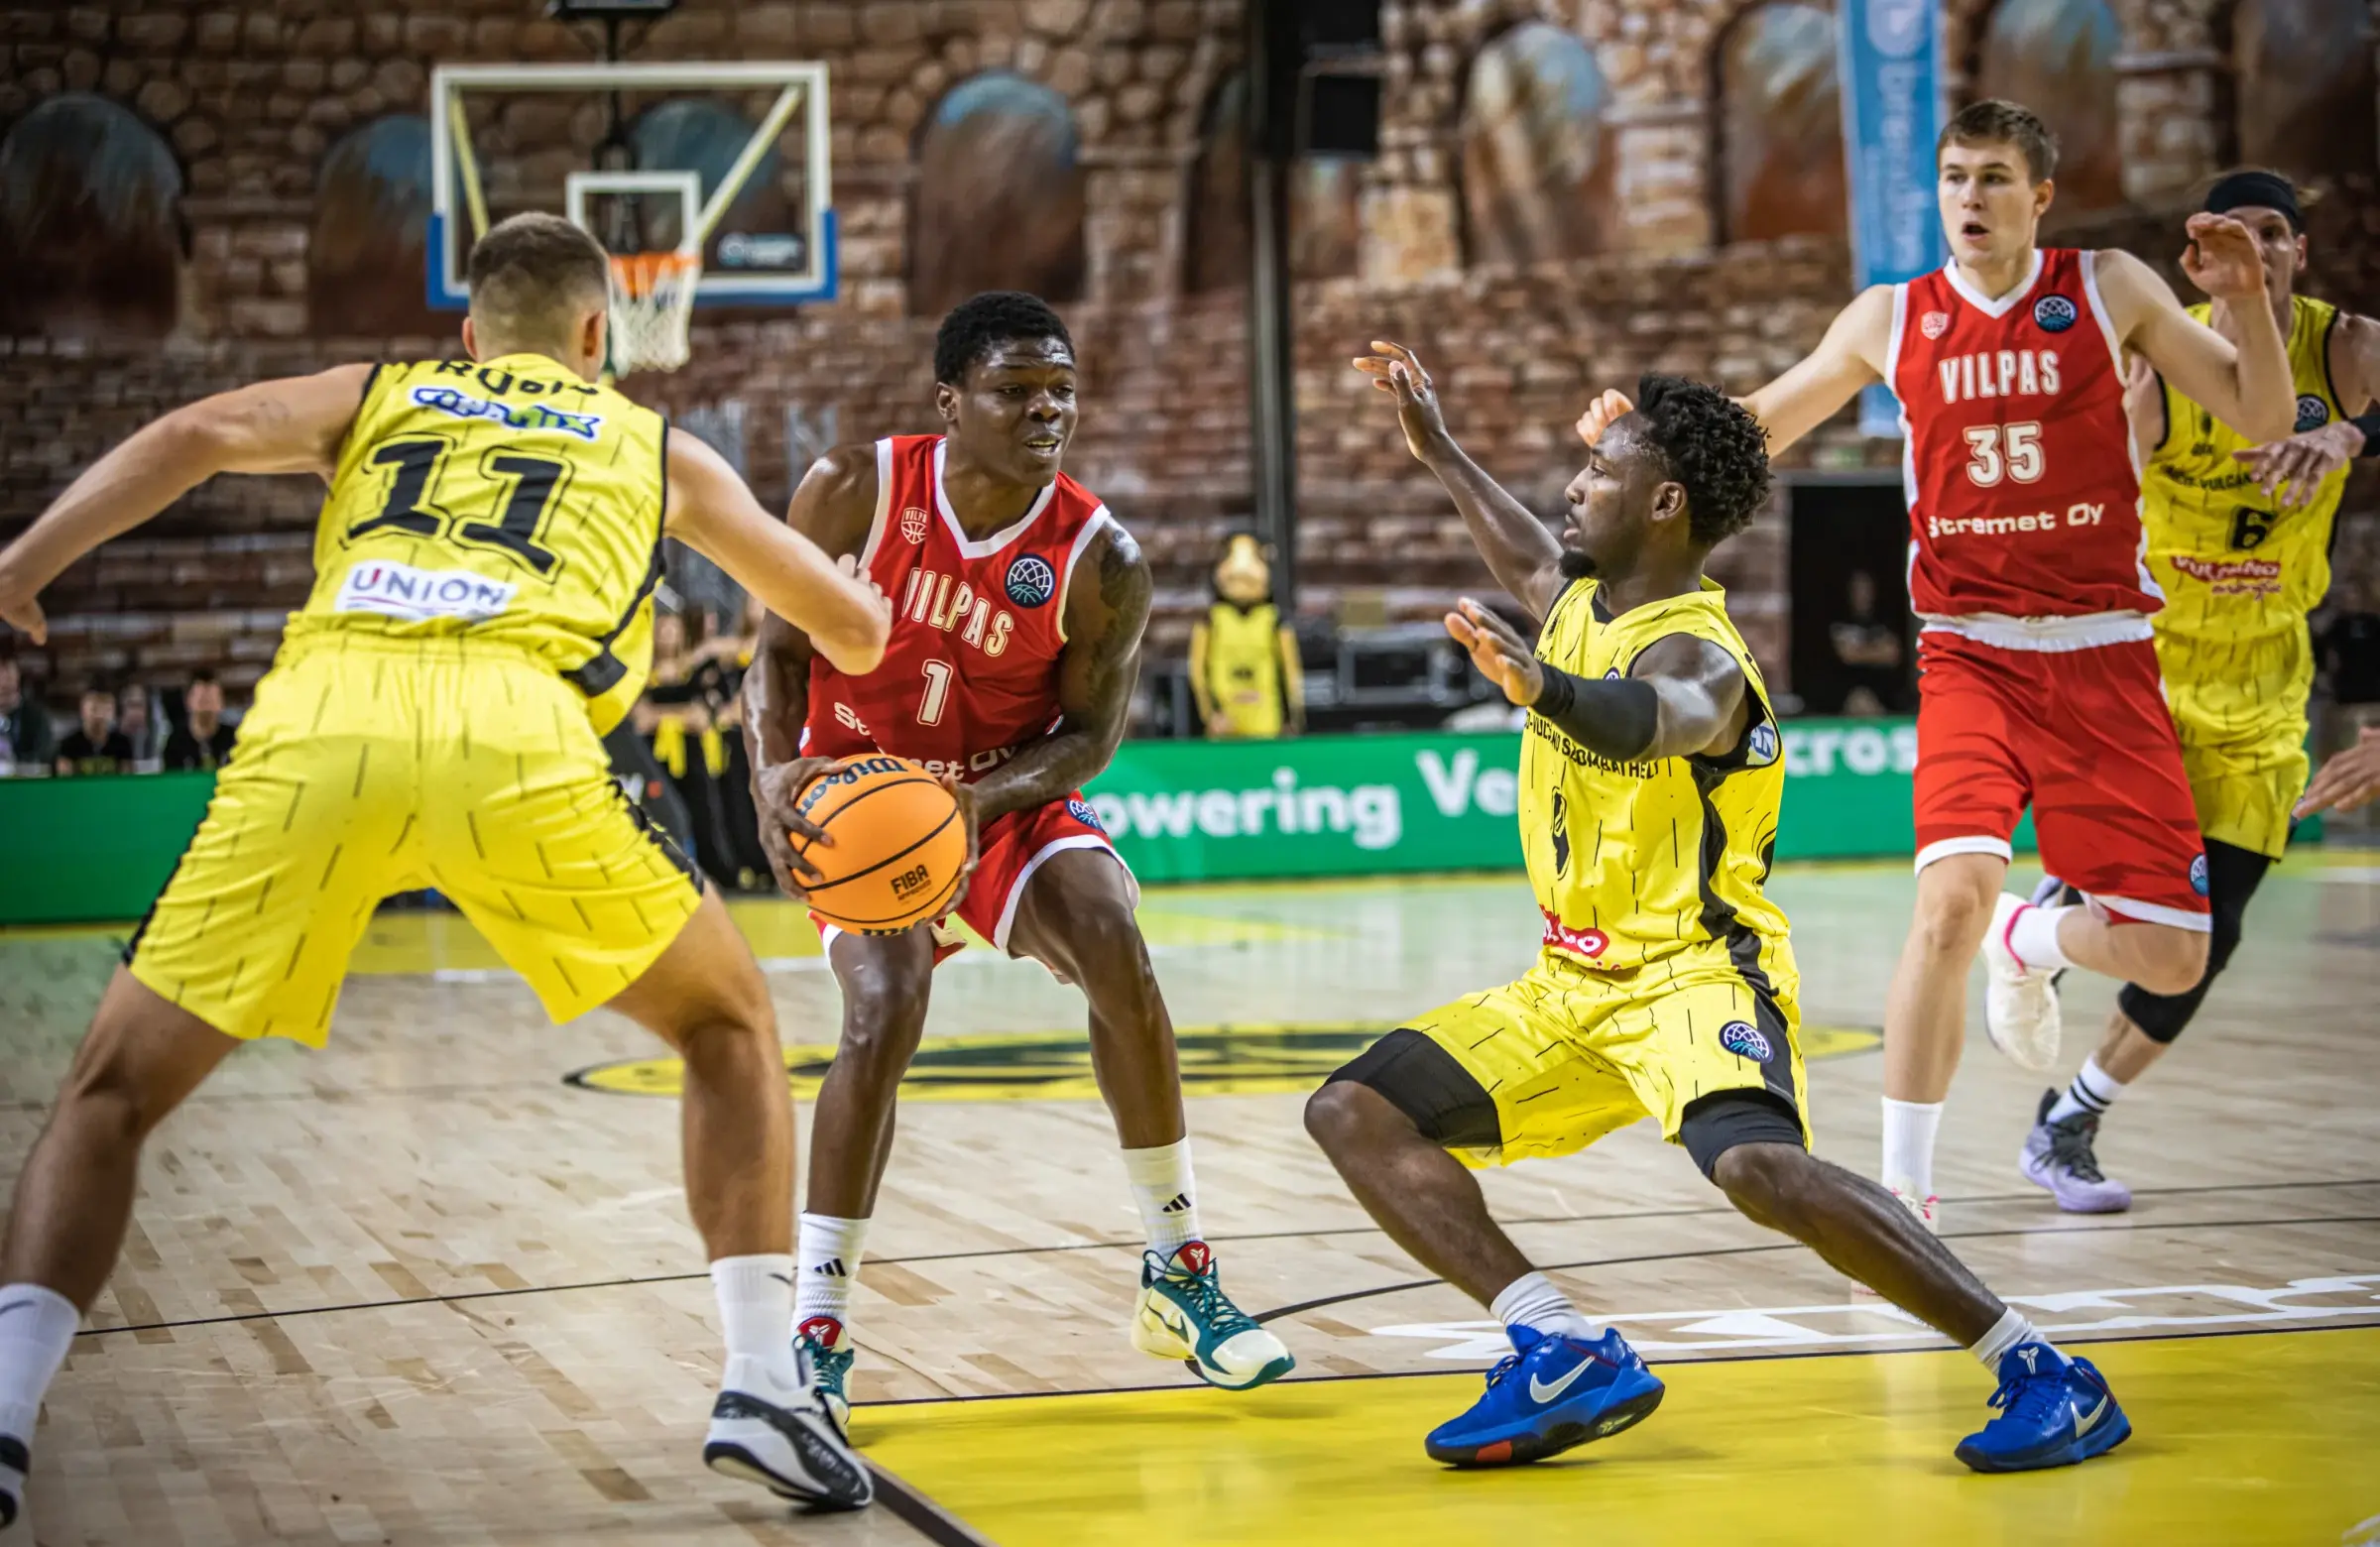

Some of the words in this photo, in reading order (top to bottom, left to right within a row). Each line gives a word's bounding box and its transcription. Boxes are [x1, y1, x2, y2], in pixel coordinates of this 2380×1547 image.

[1938, 349, 2062, 404] VILPAS
[1964, 420, 2046, 488] 35
[343, 432, 572, 583] 11
[2067, 503, 2105, 526] Oy
[2227, 505, 2277, 551] 6
[352, 567, 506, 606] UNION
[917, 658, 953, 726] 1
[1091, 766, 1402, 850] owering
[891, 864, 930, 894] FIBA
